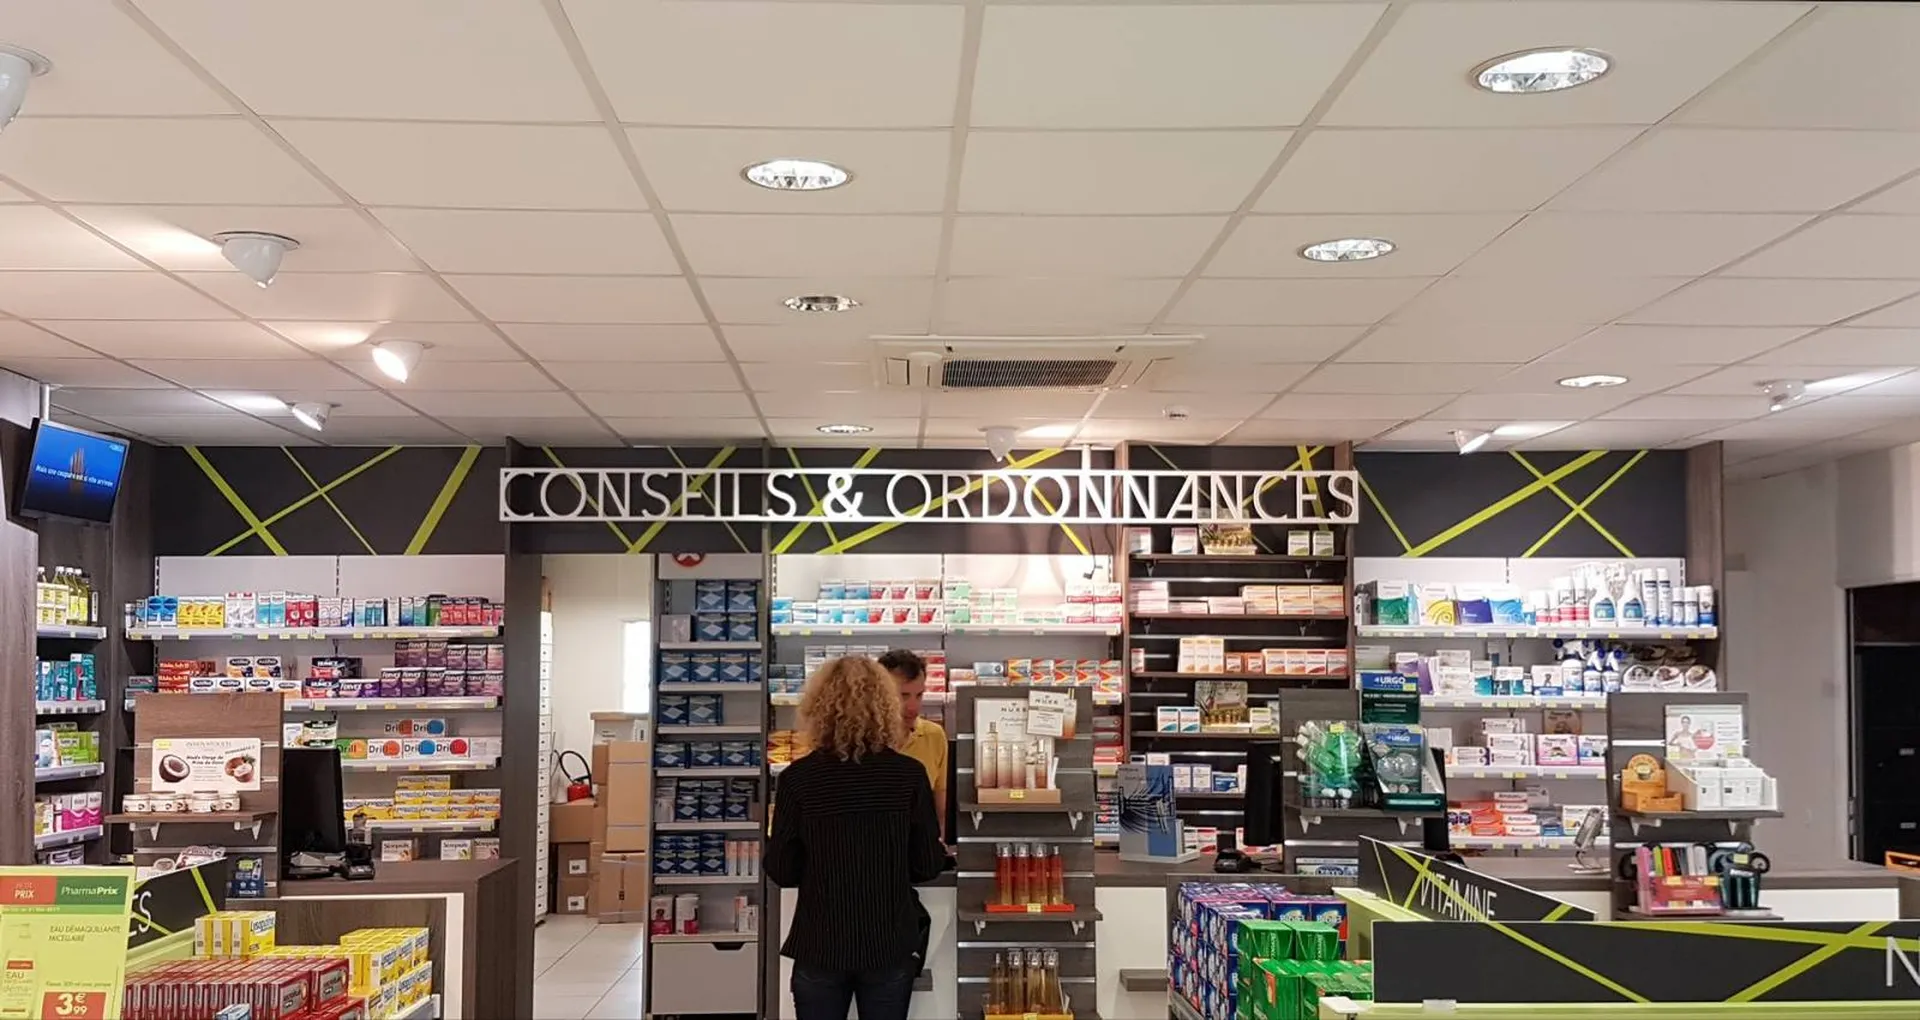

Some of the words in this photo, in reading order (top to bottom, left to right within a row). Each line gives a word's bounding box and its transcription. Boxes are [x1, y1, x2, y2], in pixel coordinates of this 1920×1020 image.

[503, 470, 798, 519] CONSEILS
[821, 469, 864, 519] &
[886, 470, 1356, 521] ORDONNANCES
[14, 889, 35, 899] PRIX
[1420, 871, 1498, 922] VITAMINE
[5, 971, 25, 980] EAU
